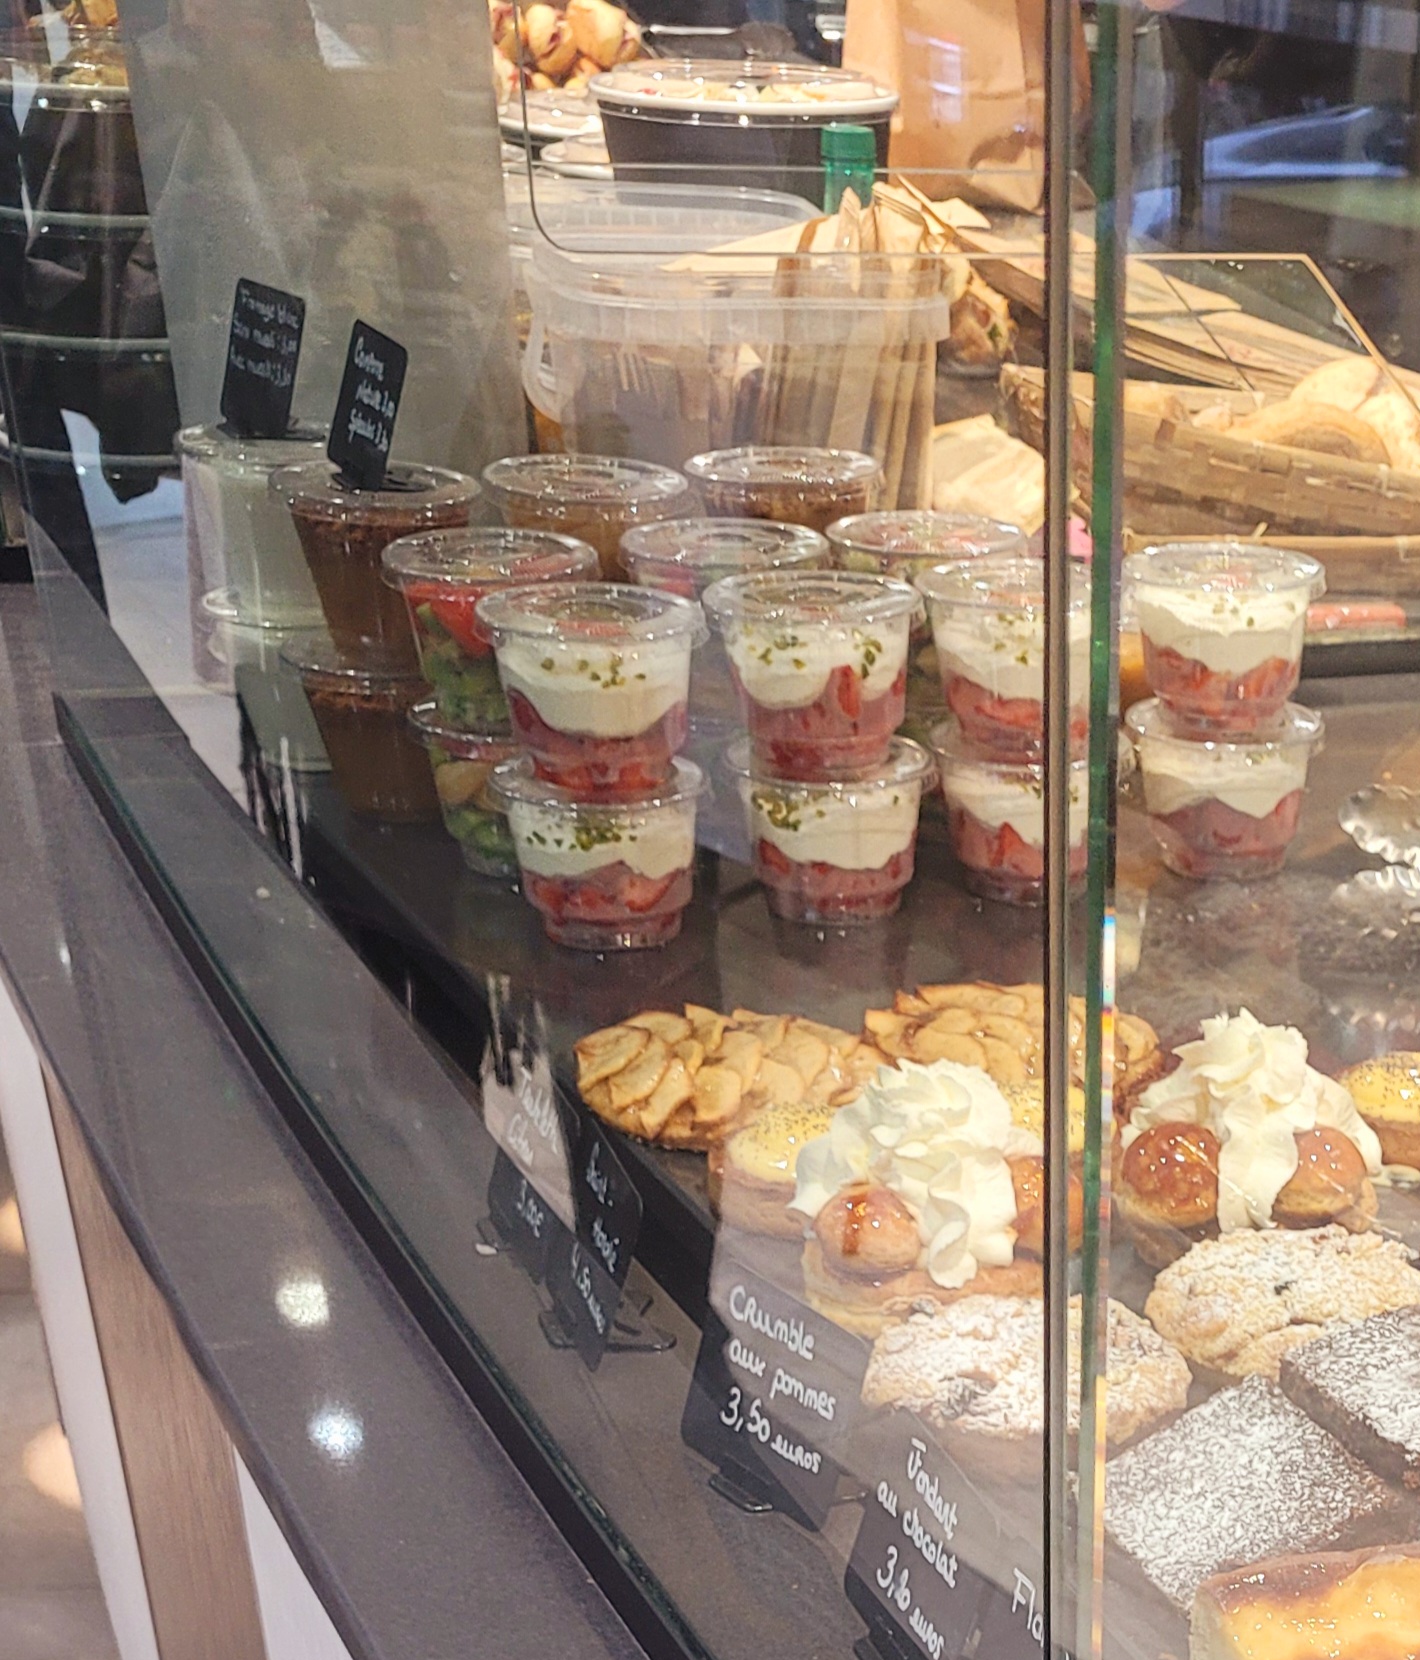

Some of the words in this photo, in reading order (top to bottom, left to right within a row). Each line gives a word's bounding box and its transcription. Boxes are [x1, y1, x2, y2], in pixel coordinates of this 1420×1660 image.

[728, 1338, 767, 1377] aux
[769, 1368, 837, 1421] pommes
[719, 1386, 771, 1443] 3,50
[770, 1434, 822, 1475] euros
[876, 1480, 898, 1518] au
[902, 1507, 958, 1589] chocolat
[907, 1437, 958, 1540] Fondant
